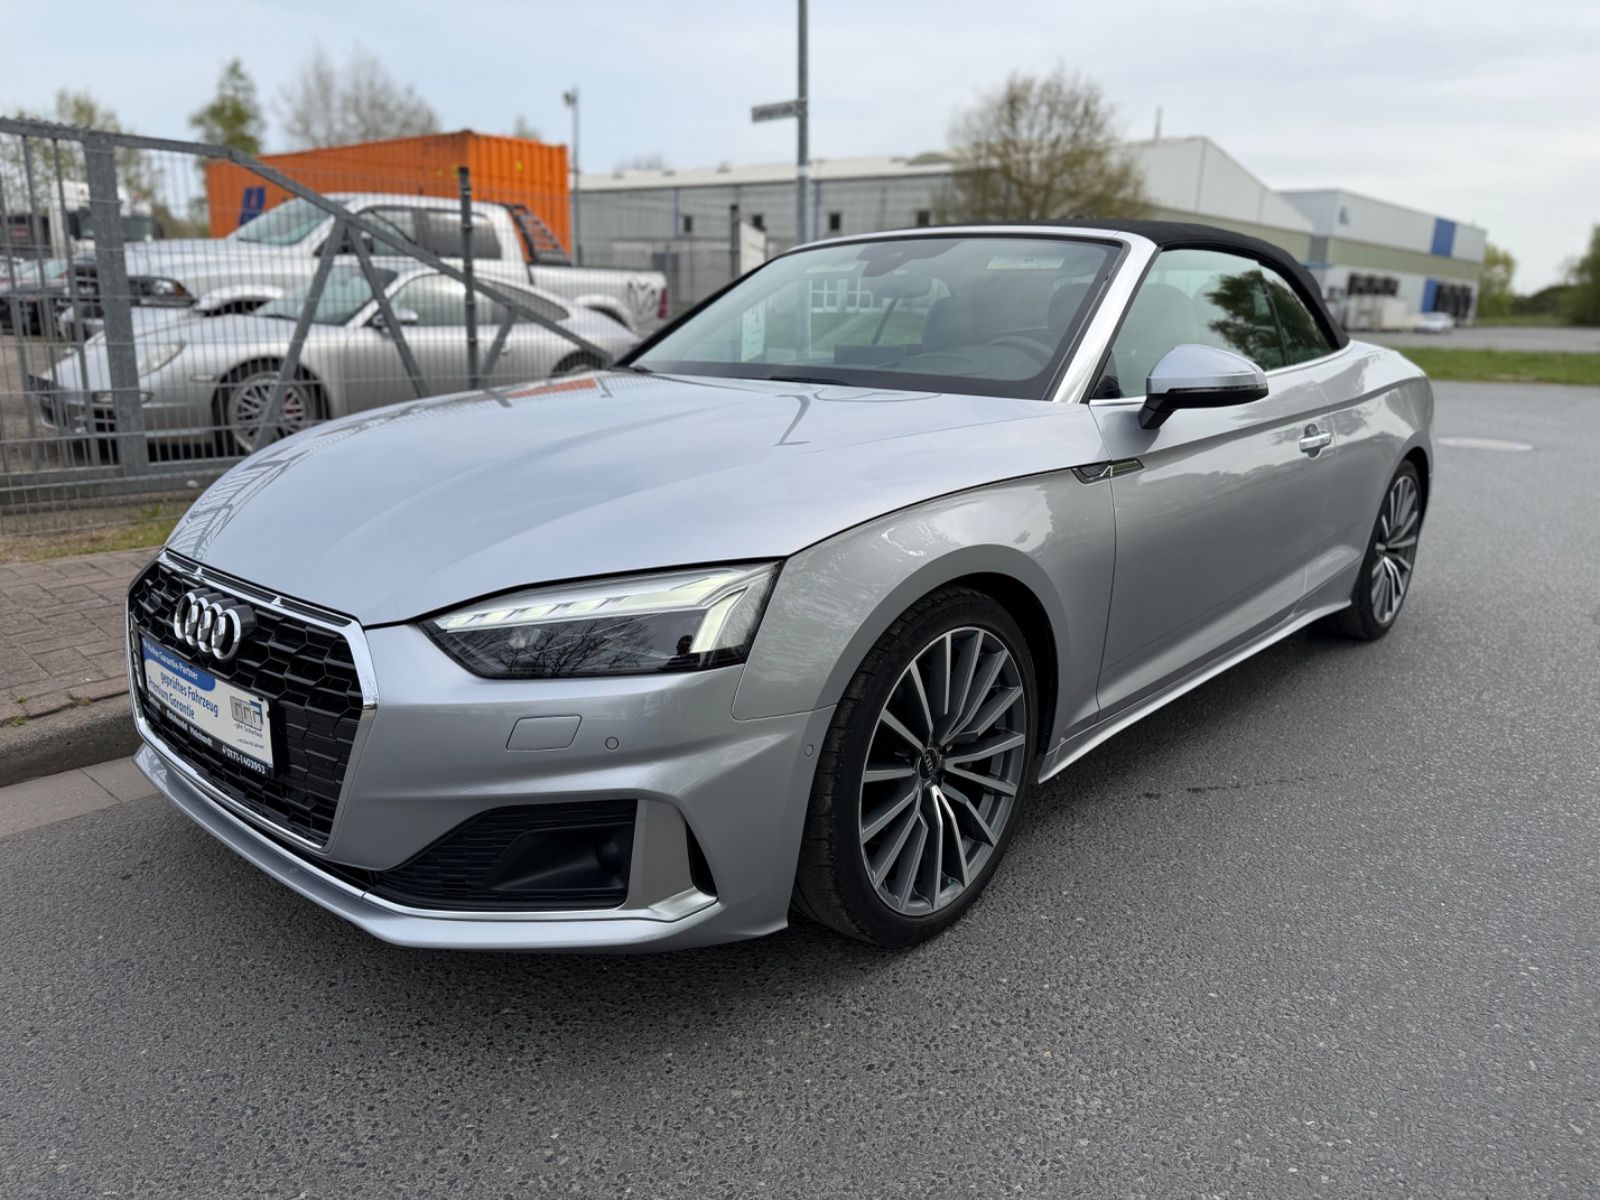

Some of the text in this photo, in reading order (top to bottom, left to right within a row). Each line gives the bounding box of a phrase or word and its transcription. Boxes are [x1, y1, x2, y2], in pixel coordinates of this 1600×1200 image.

[160, 672, 187, 696] geprüftes
[187, 686, 219, 718] Fahrzeug
[168, 692, 195, 720] Garantie
